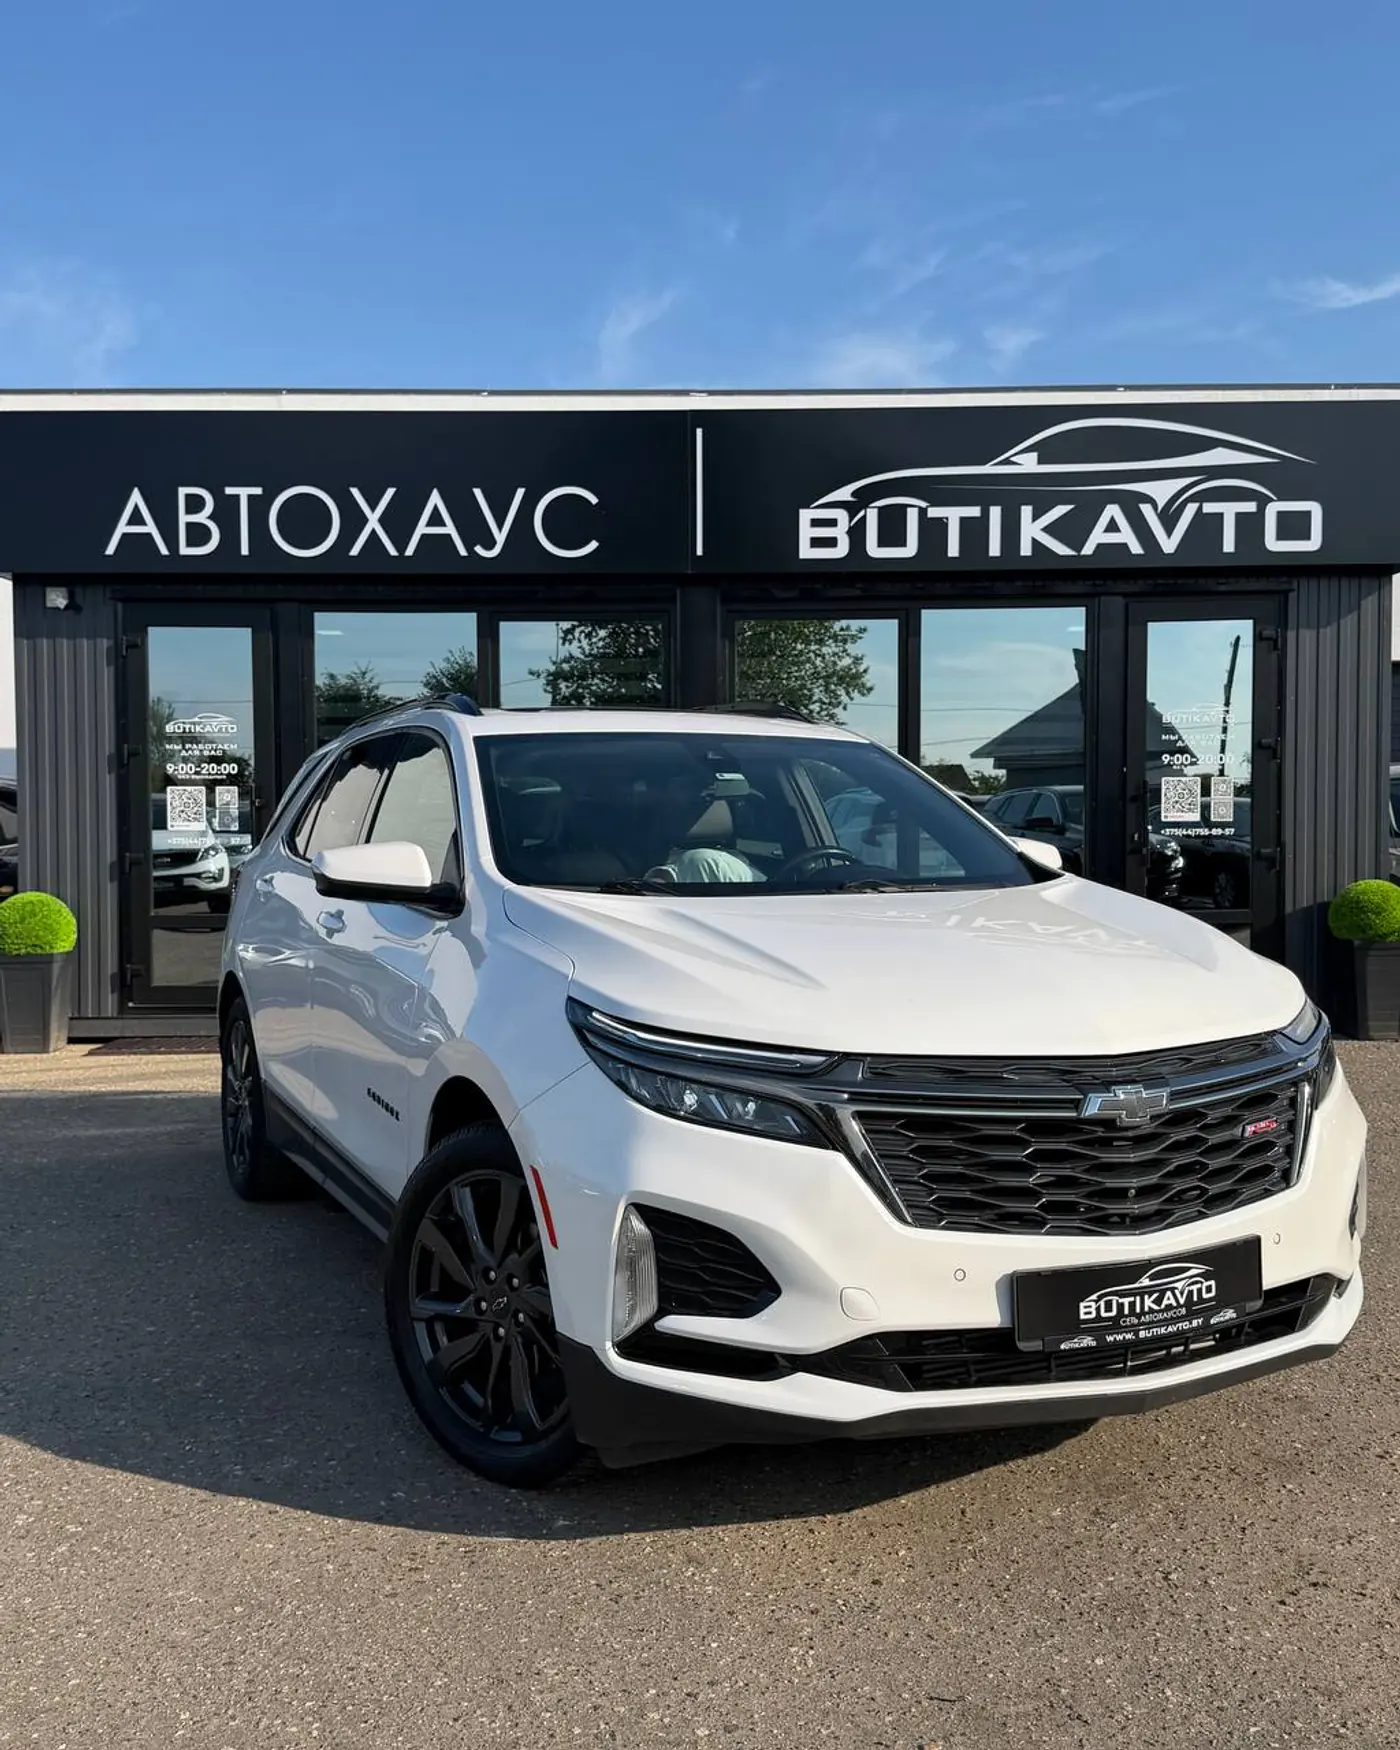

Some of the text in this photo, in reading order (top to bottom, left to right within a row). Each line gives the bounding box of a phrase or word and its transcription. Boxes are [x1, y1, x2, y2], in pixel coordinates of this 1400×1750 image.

[105, 485, 601, 558] АВТОХАУС
[798, 499, 1324, 560] BUTIKAVTO
[165, 723, 237, 733] BUTIKAVTO
[166, 763, 238, 774] 9:00-20:00
[1161, 753, 1234, 765] 9:00-20:00
[1079, 1280, 1217, 1320] BUTIKAVTO
[1120, 1308, 1187, 1326] СЕТЬ АВТОХАУСОВ
[1139, 1317, 1204, 1339] BUTIKAVTO.BY
